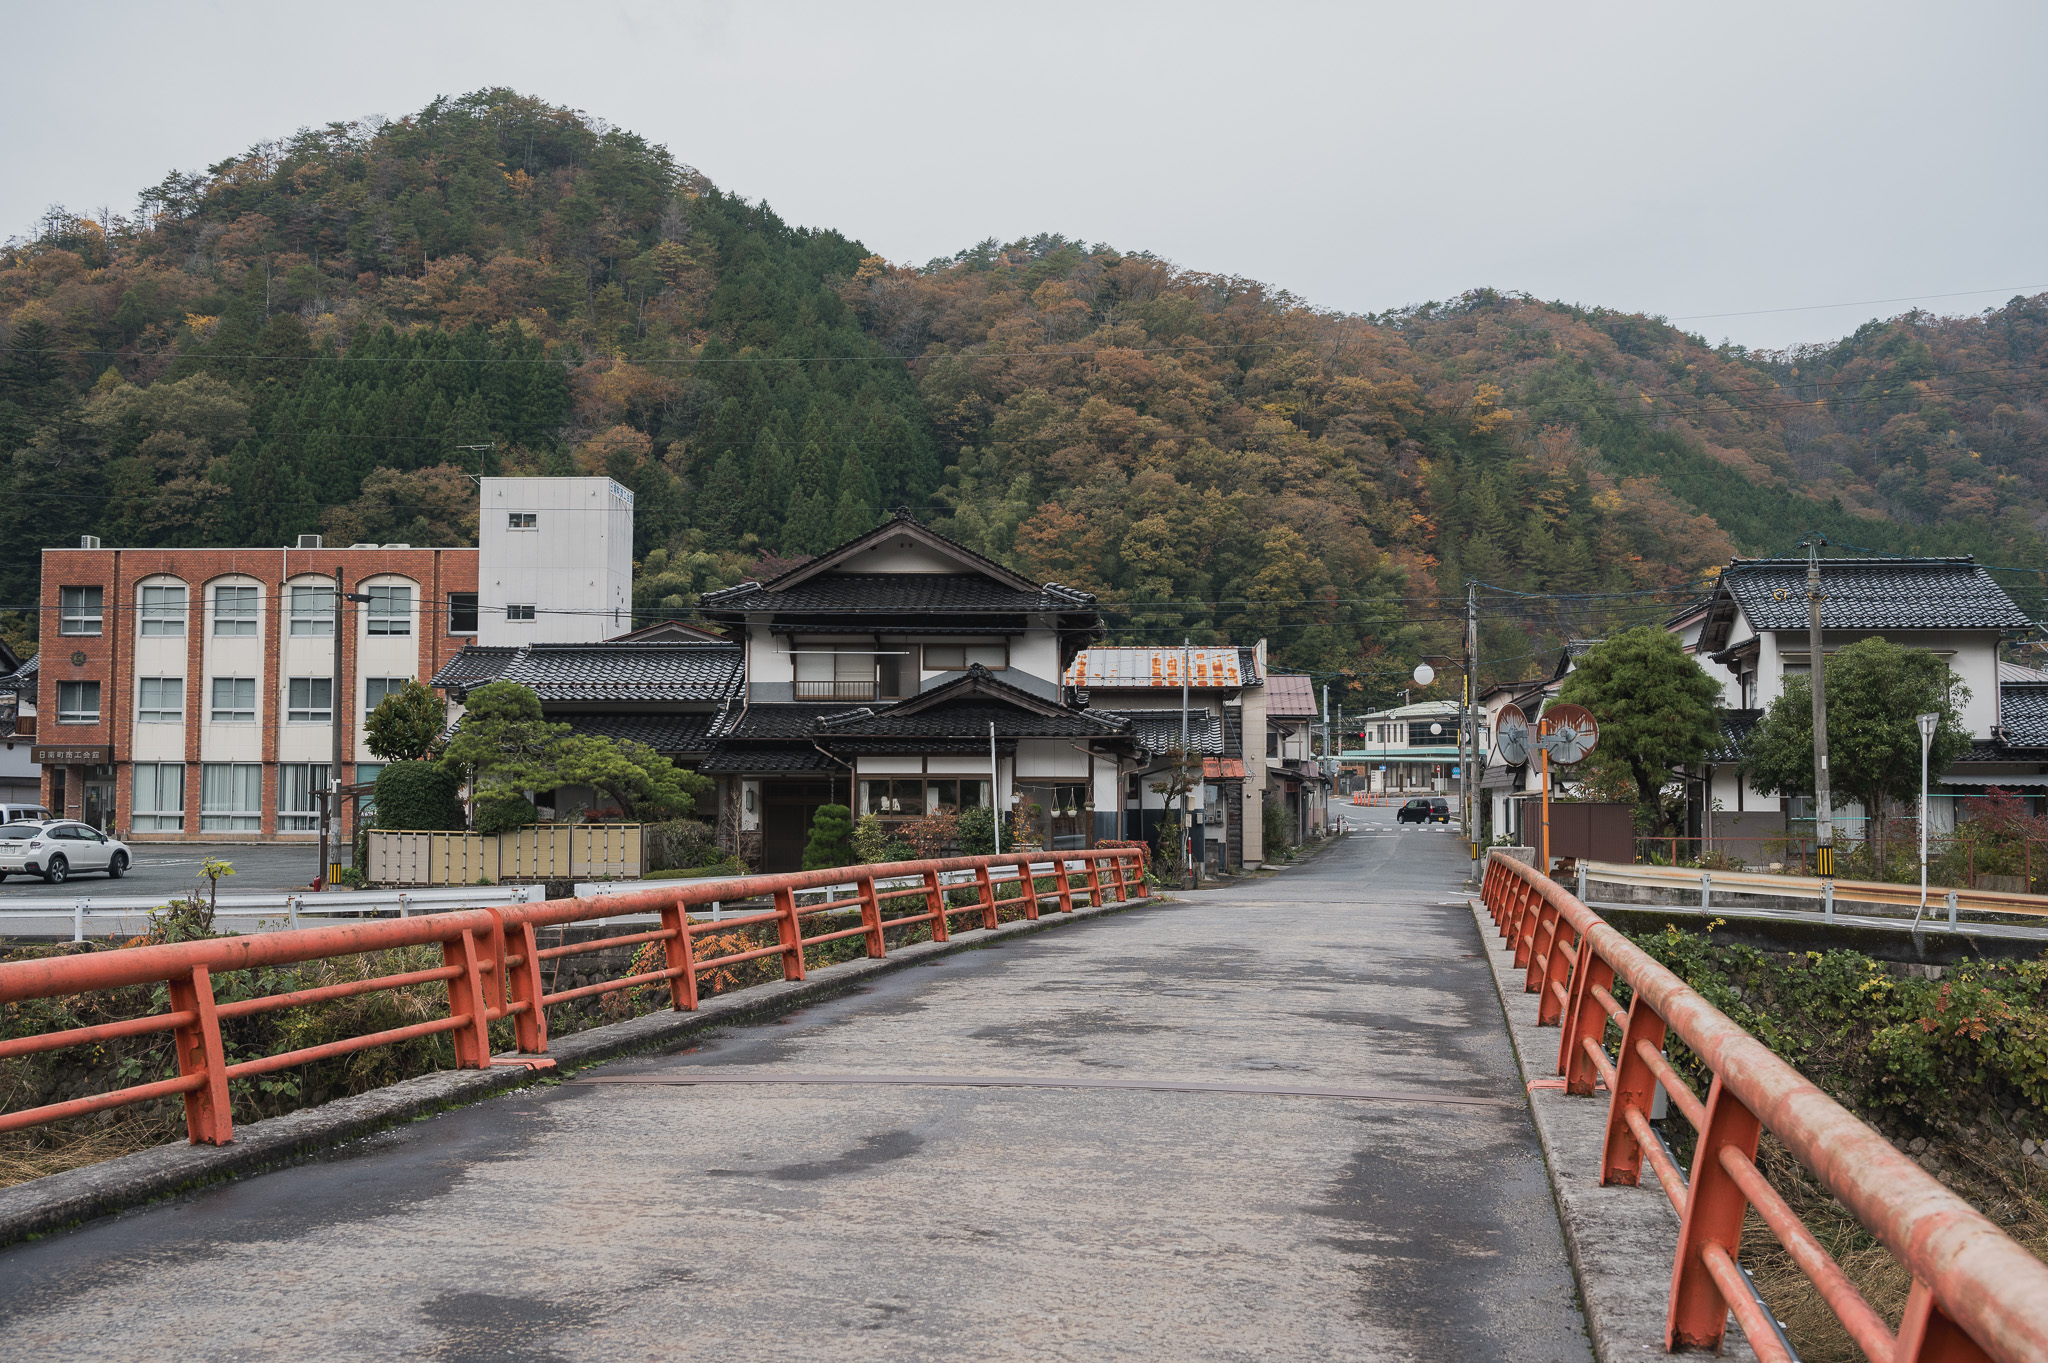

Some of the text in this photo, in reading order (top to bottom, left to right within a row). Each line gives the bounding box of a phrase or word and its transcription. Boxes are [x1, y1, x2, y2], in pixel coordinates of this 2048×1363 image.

[39, 750, 100, 759] 日南町商工会館
